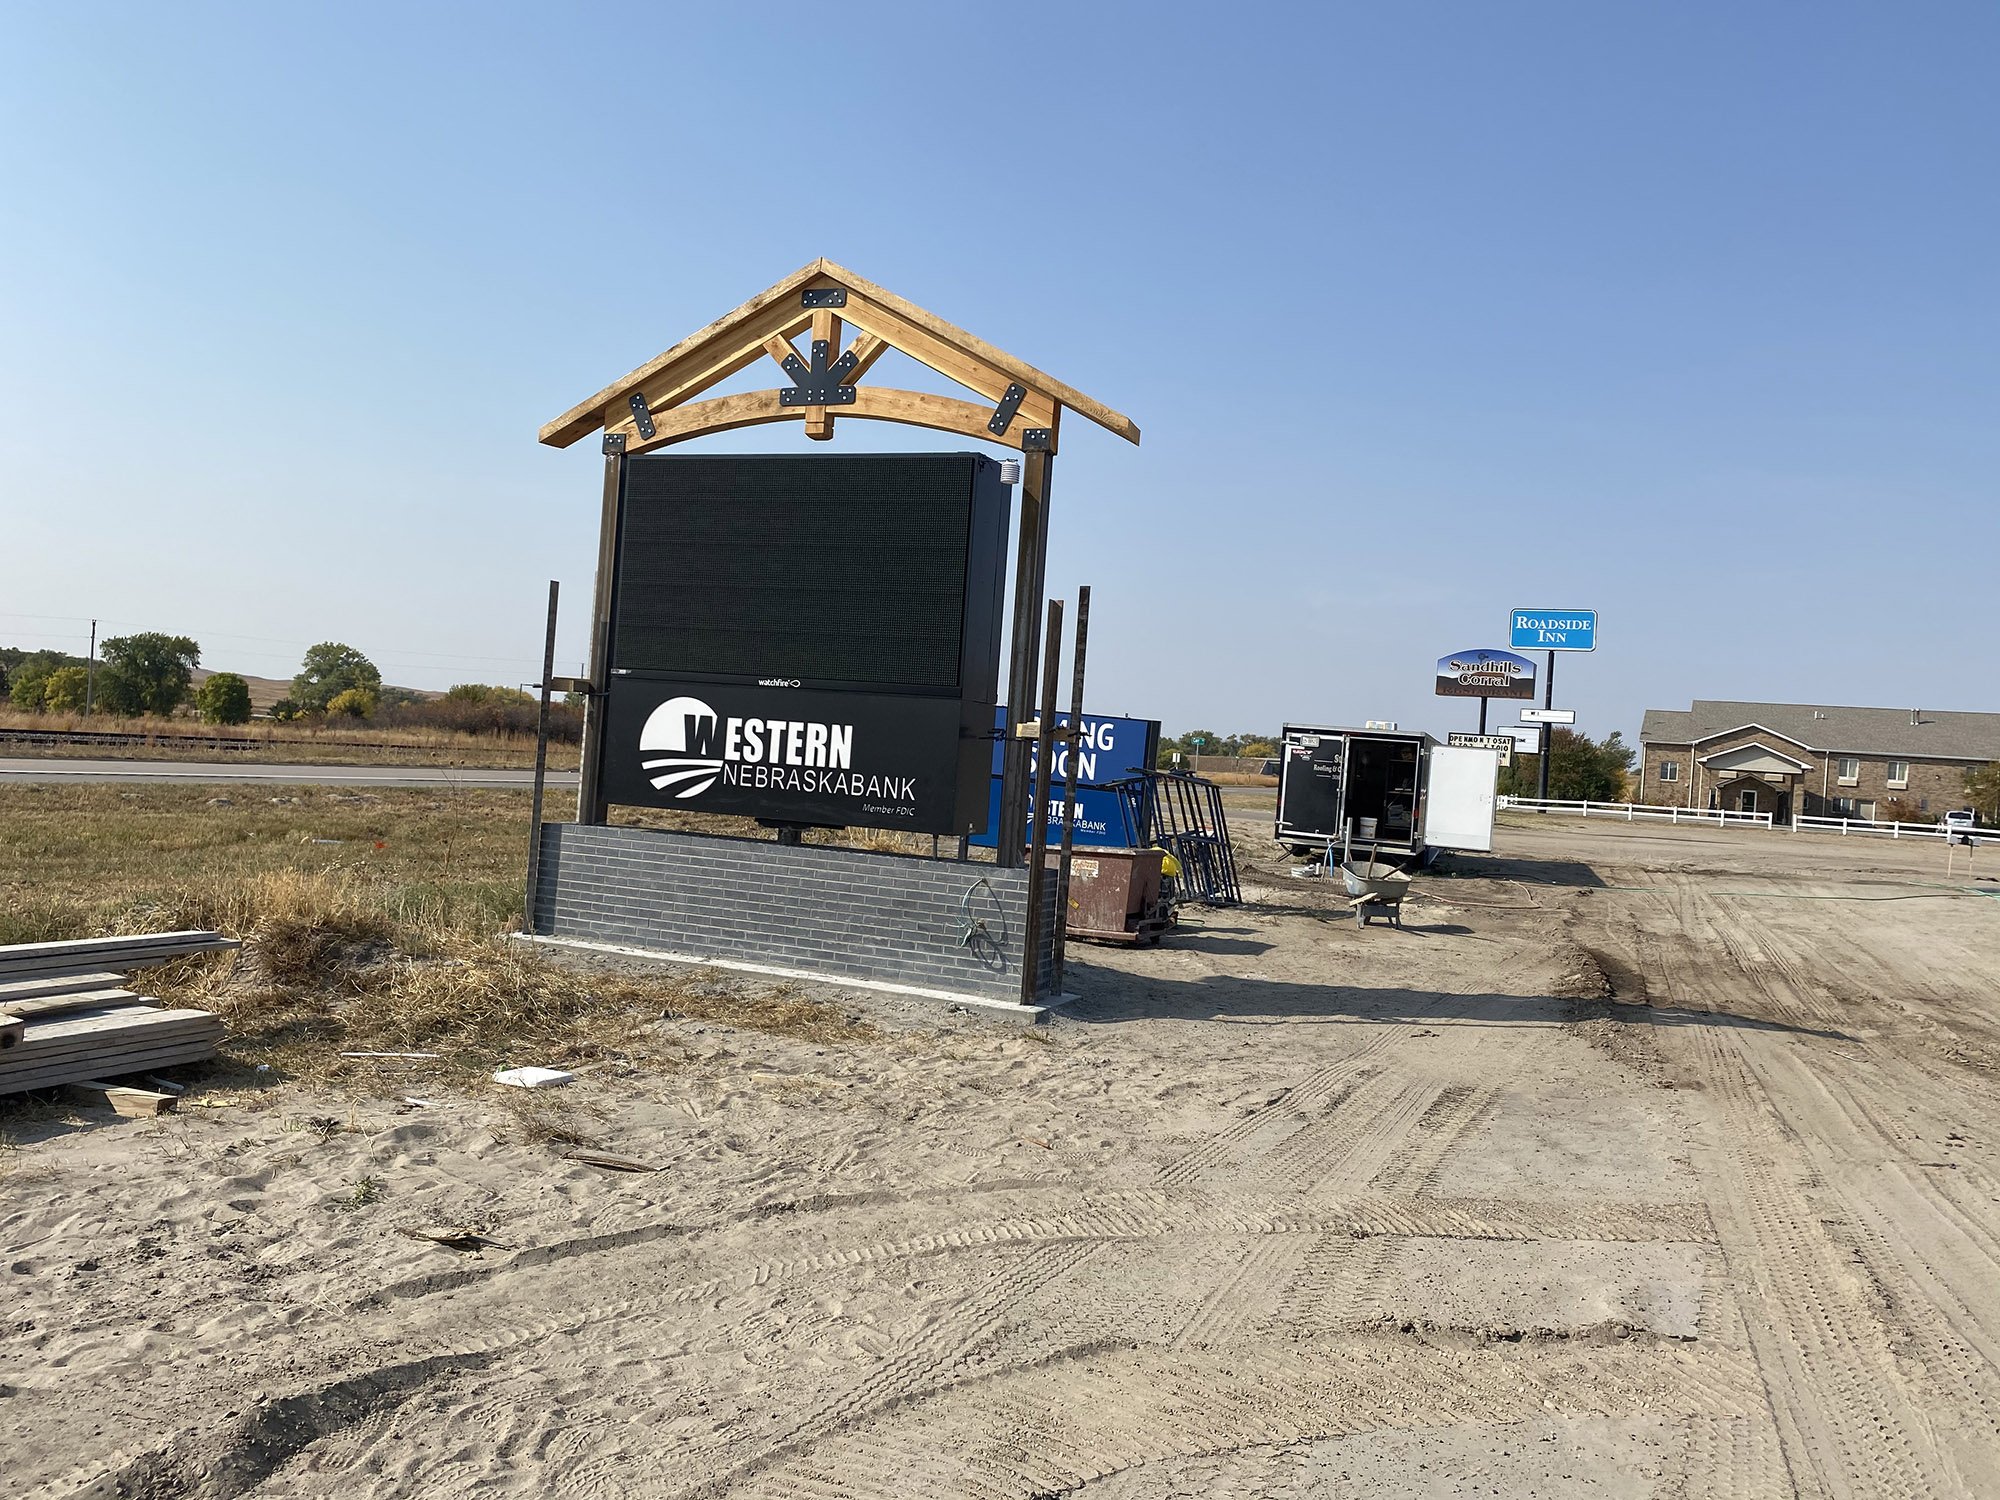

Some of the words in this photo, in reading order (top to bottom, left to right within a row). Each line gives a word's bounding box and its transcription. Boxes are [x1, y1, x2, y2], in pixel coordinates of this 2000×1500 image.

[1515, 616, 1591, 630] ROADSIDE
[1537, 629, 1567, 643] INN
[1449, 660, 1522, 673] Sandhills
[758, 678, 789, 687] watchfire
[1458, 673, 1510, 687] Corral
[862, 803, 895, 815] Member
[895, 806, 916, 816] FDIC
